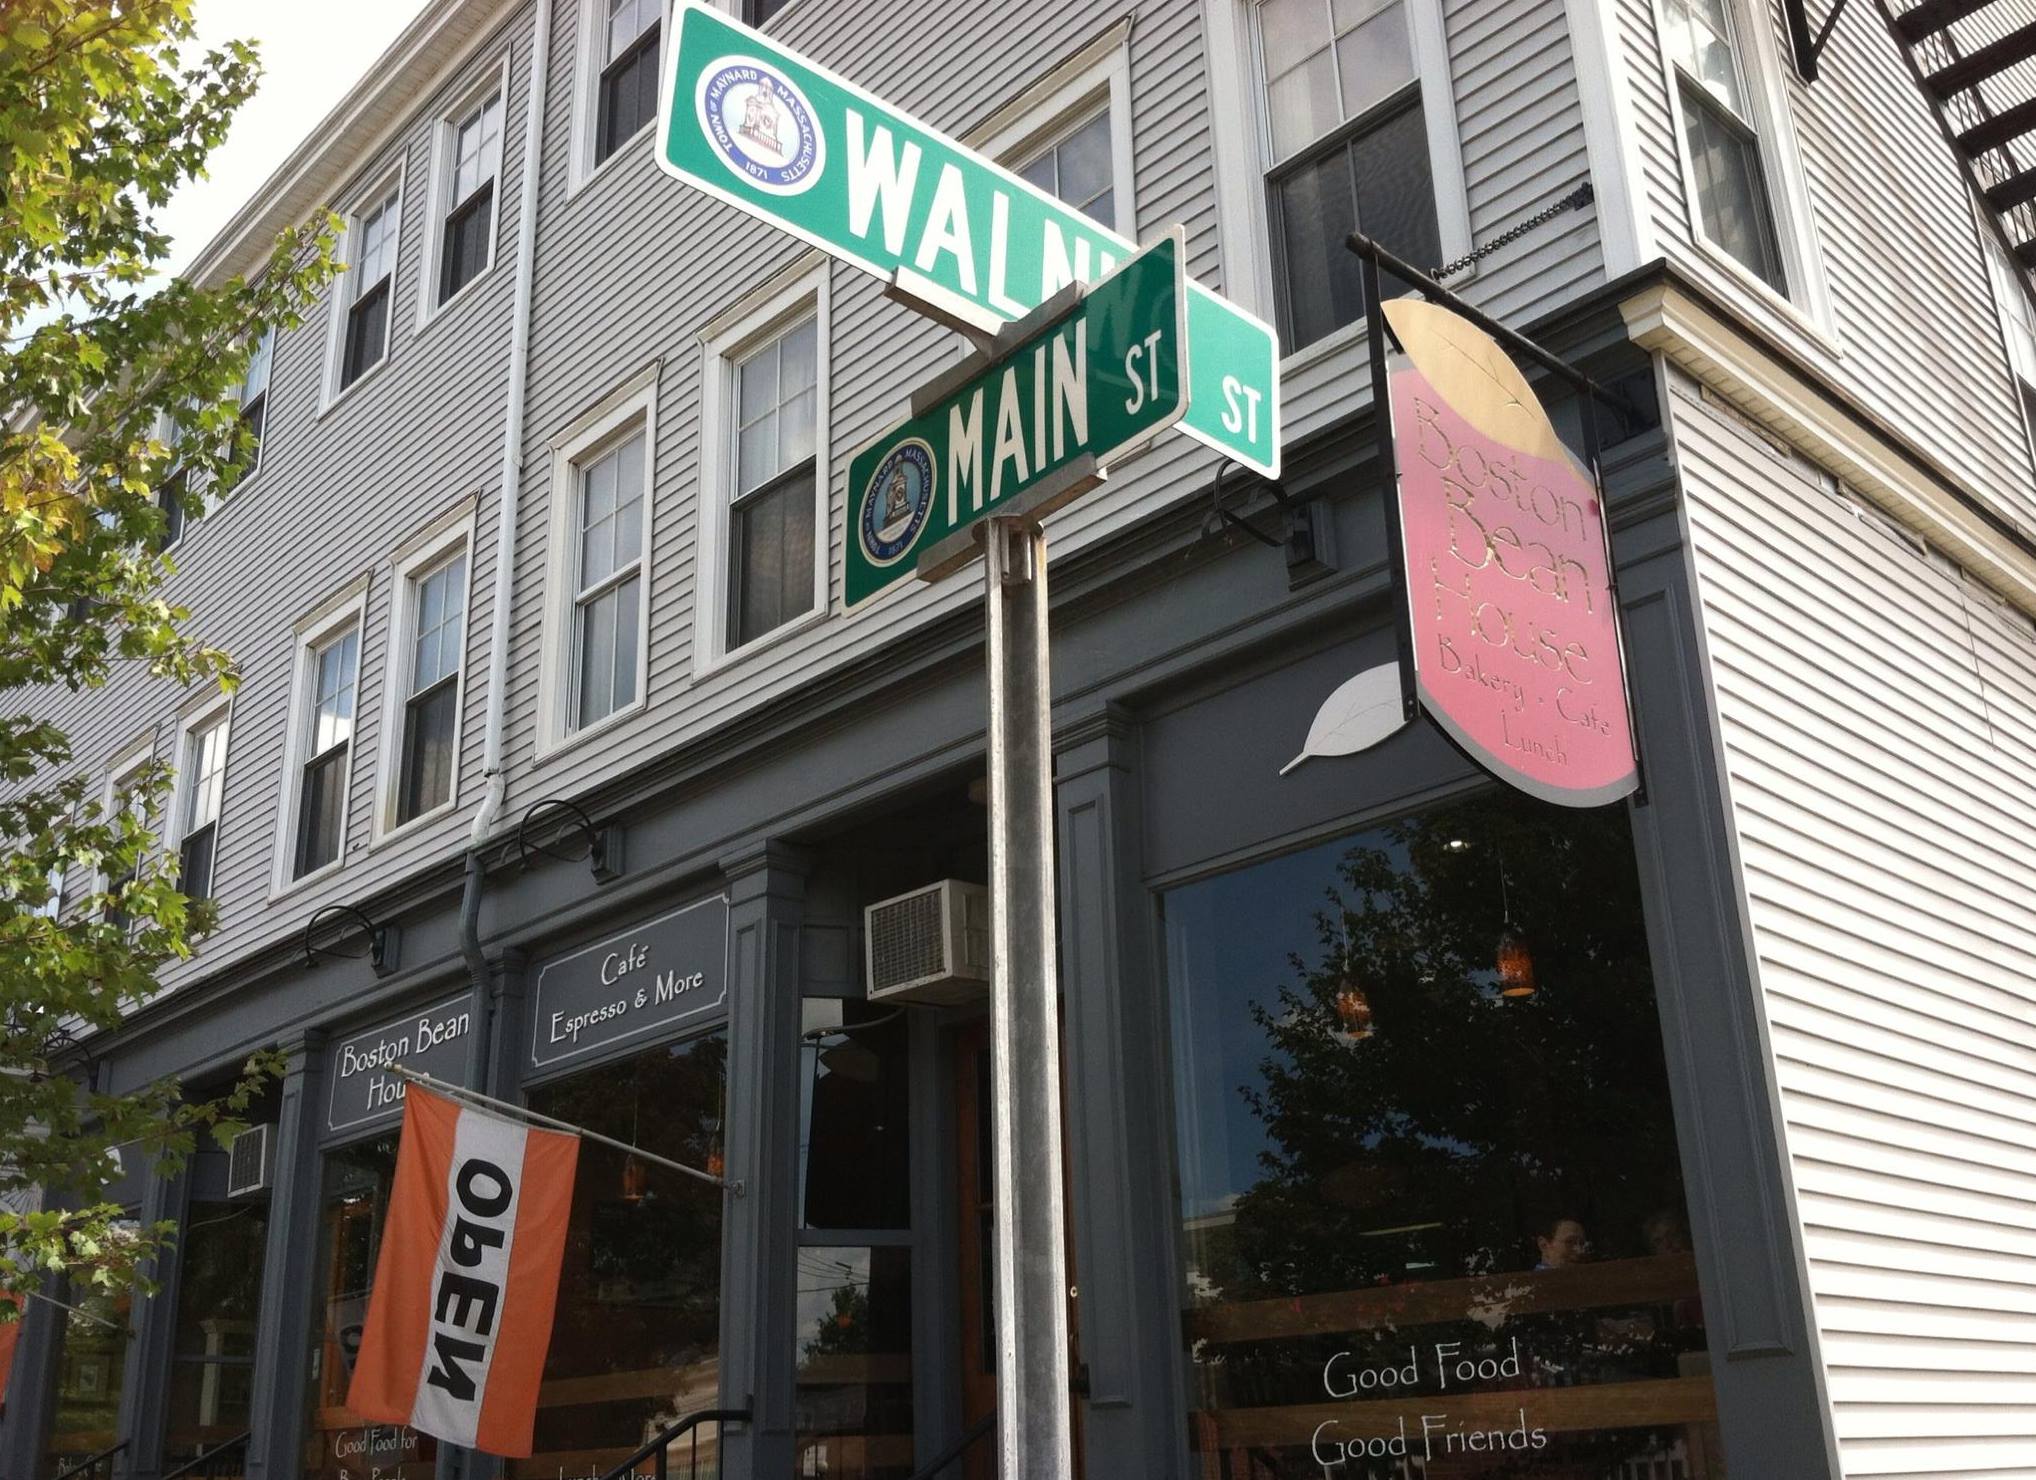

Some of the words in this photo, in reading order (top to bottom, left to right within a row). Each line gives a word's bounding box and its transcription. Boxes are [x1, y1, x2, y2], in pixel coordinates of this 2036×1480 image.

[710, 69, 758, 100] MAYNARD
[710, 114, 733, 153] TOWN
[777, 85, 814, 182] MASSACHUSETTS
[745, 161, 768, 180] 1871
[845, 108, 1118, 318] WALN
[1221, 375, 1263, 444] ST
[948, 318, 1087, 526] MAIN
[1125, 330, 1163, 415] ST
[1413, 398, 1588, 542] Boston
[1442, 476, 1594, 615] Bean
[1430, 557, 1593, 685] House
[1437, 632, 1525, 712] Bakery
[1500, 709, 1568, 766] Lunch
[601, 944, 650, 987] Café
[550, 999, 627, 1044] Espresso
[634, 989, 648, 1009] &
[655, 970, 704, 1006] More
[341, 1037, 409, 1077] Boston
[416, 1012, 470, 1053] Bean
[366, 1072, 429, 1110] Hou
[1323, 1344, 1419, 1398] Good
[1435, 1336, 1521, 1389] Food
[335, 1429, 368, 1458] Good
[370, 1427, 398, 1456] Food
[400, 1425, 418, 1449] for
[1311, 1415, 1407, 1467] Good
[1421, 1407, 1548, 1462] Friends
